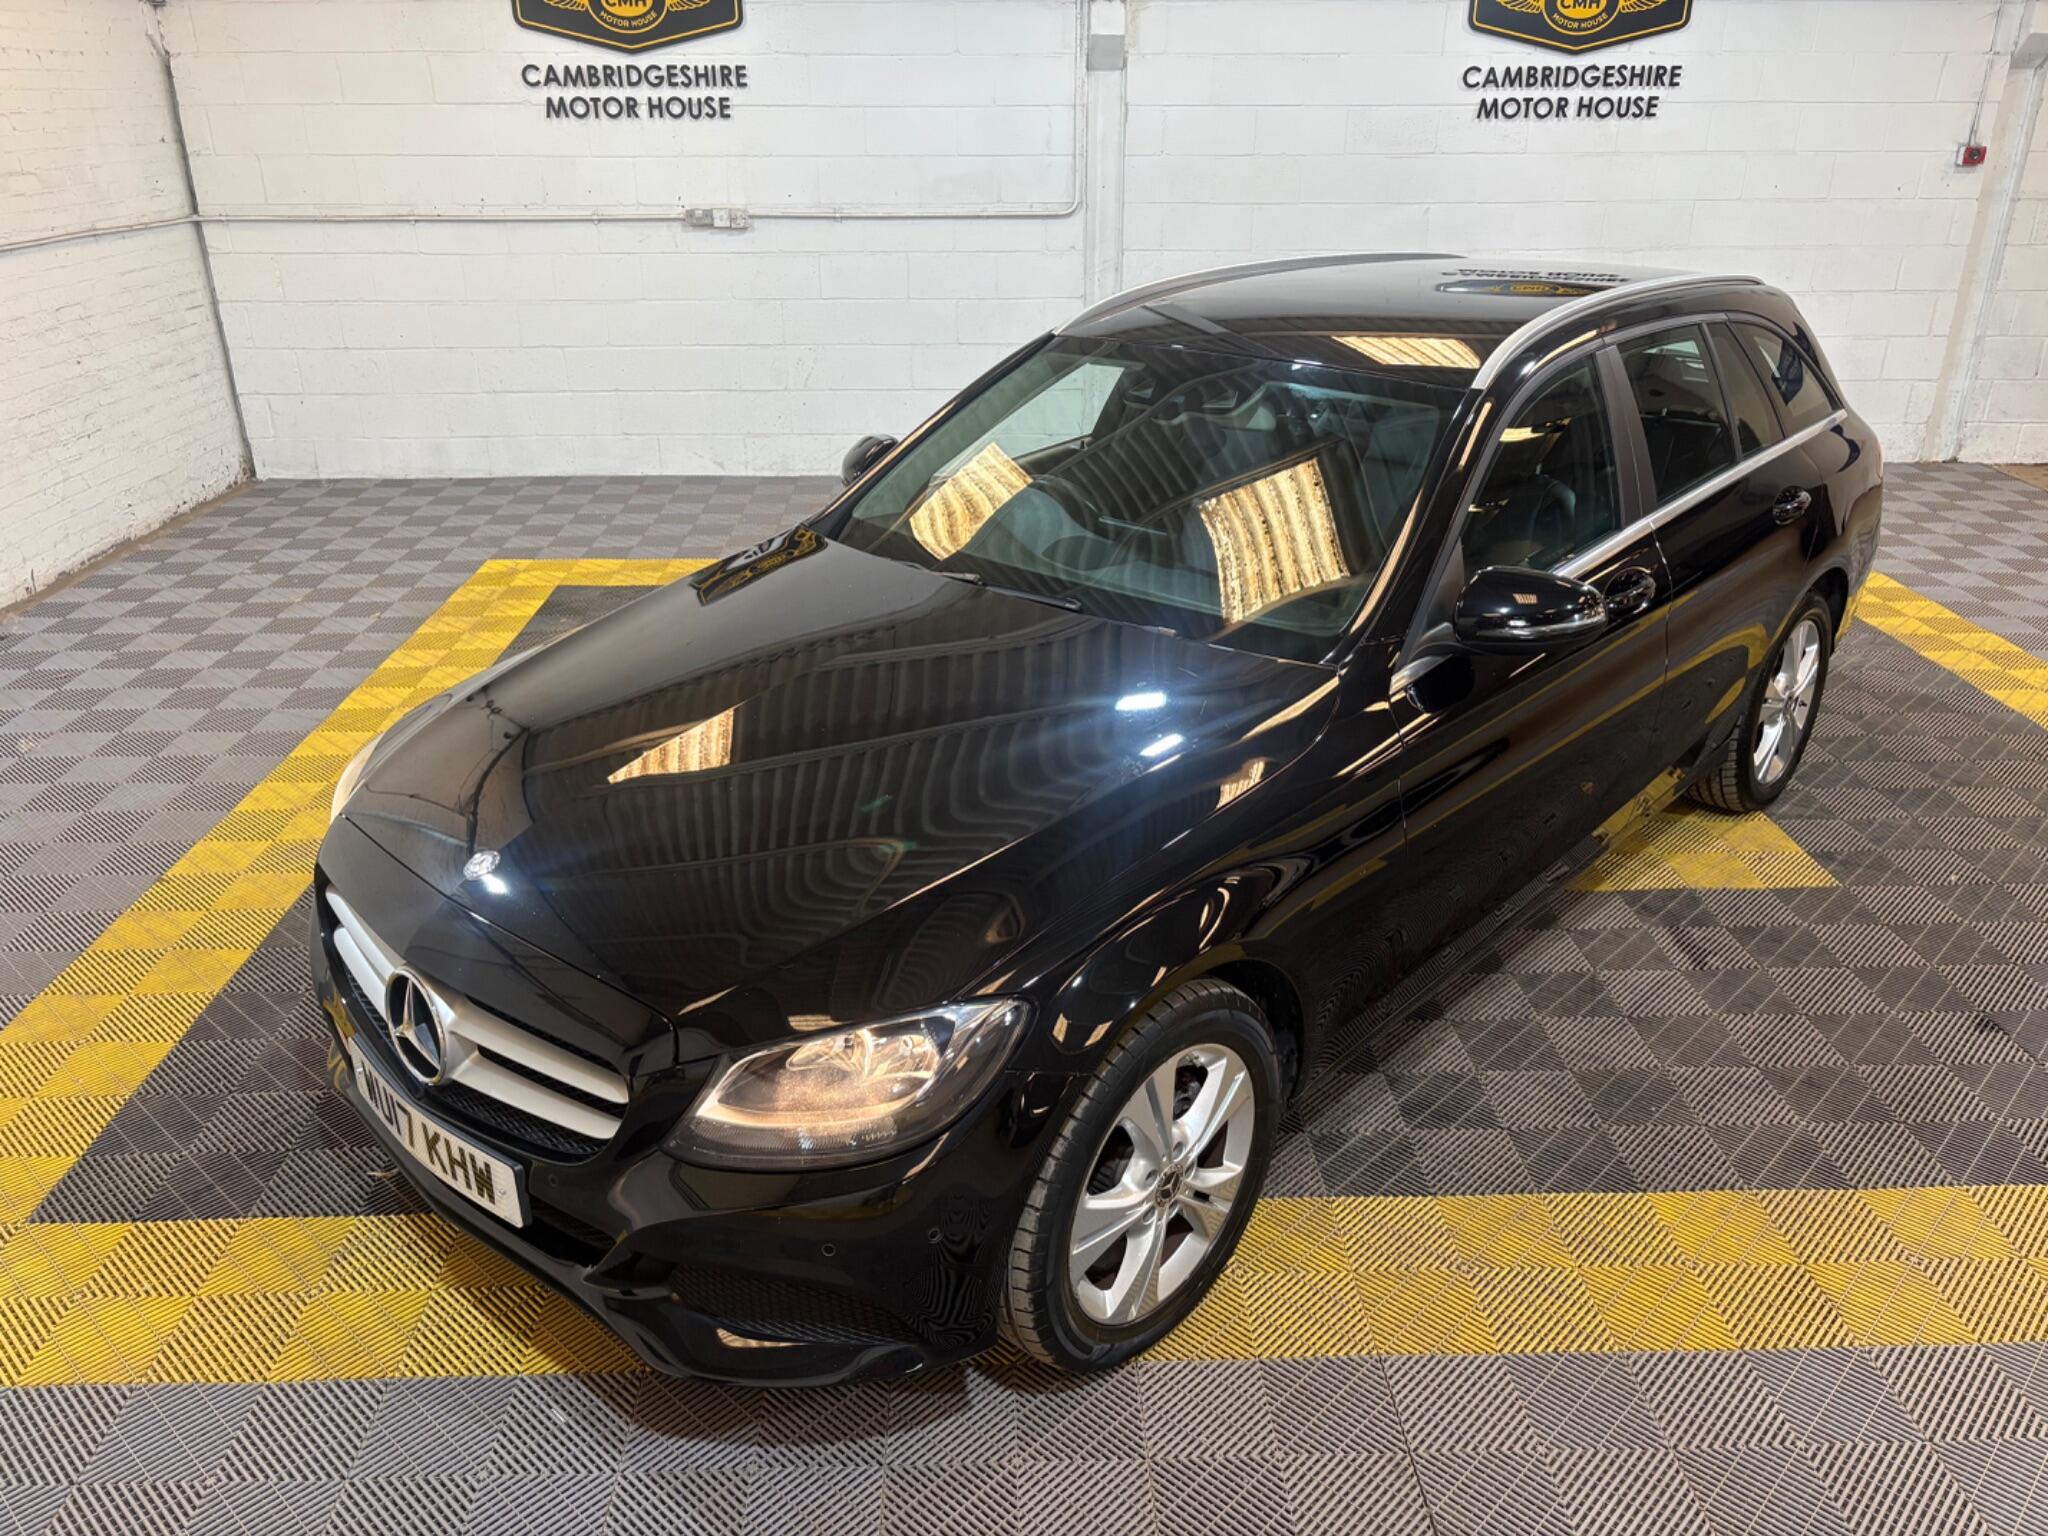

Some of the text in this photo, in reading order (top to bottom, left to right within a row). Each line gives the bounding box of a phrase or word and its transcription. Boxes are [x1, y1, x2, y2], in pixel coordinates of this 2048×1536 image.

[1560, 0, 1600, 9] CMH
[599, 10, 658, 27] MOTOR HOUSE
[1552, 12, 1609, 29] MOTOR HOUSE
[521, 64, 748, 88] CAMBRIDGESHIRE
[1462, 64, 1682, 89] CAMBRIDGESHIRE
[546, 96, 731, 119] MOTOR HOUSE
[1476, 95, 1660, 119] MOTOR HOUSE
[421, 1121, 495, 1205] KHW
